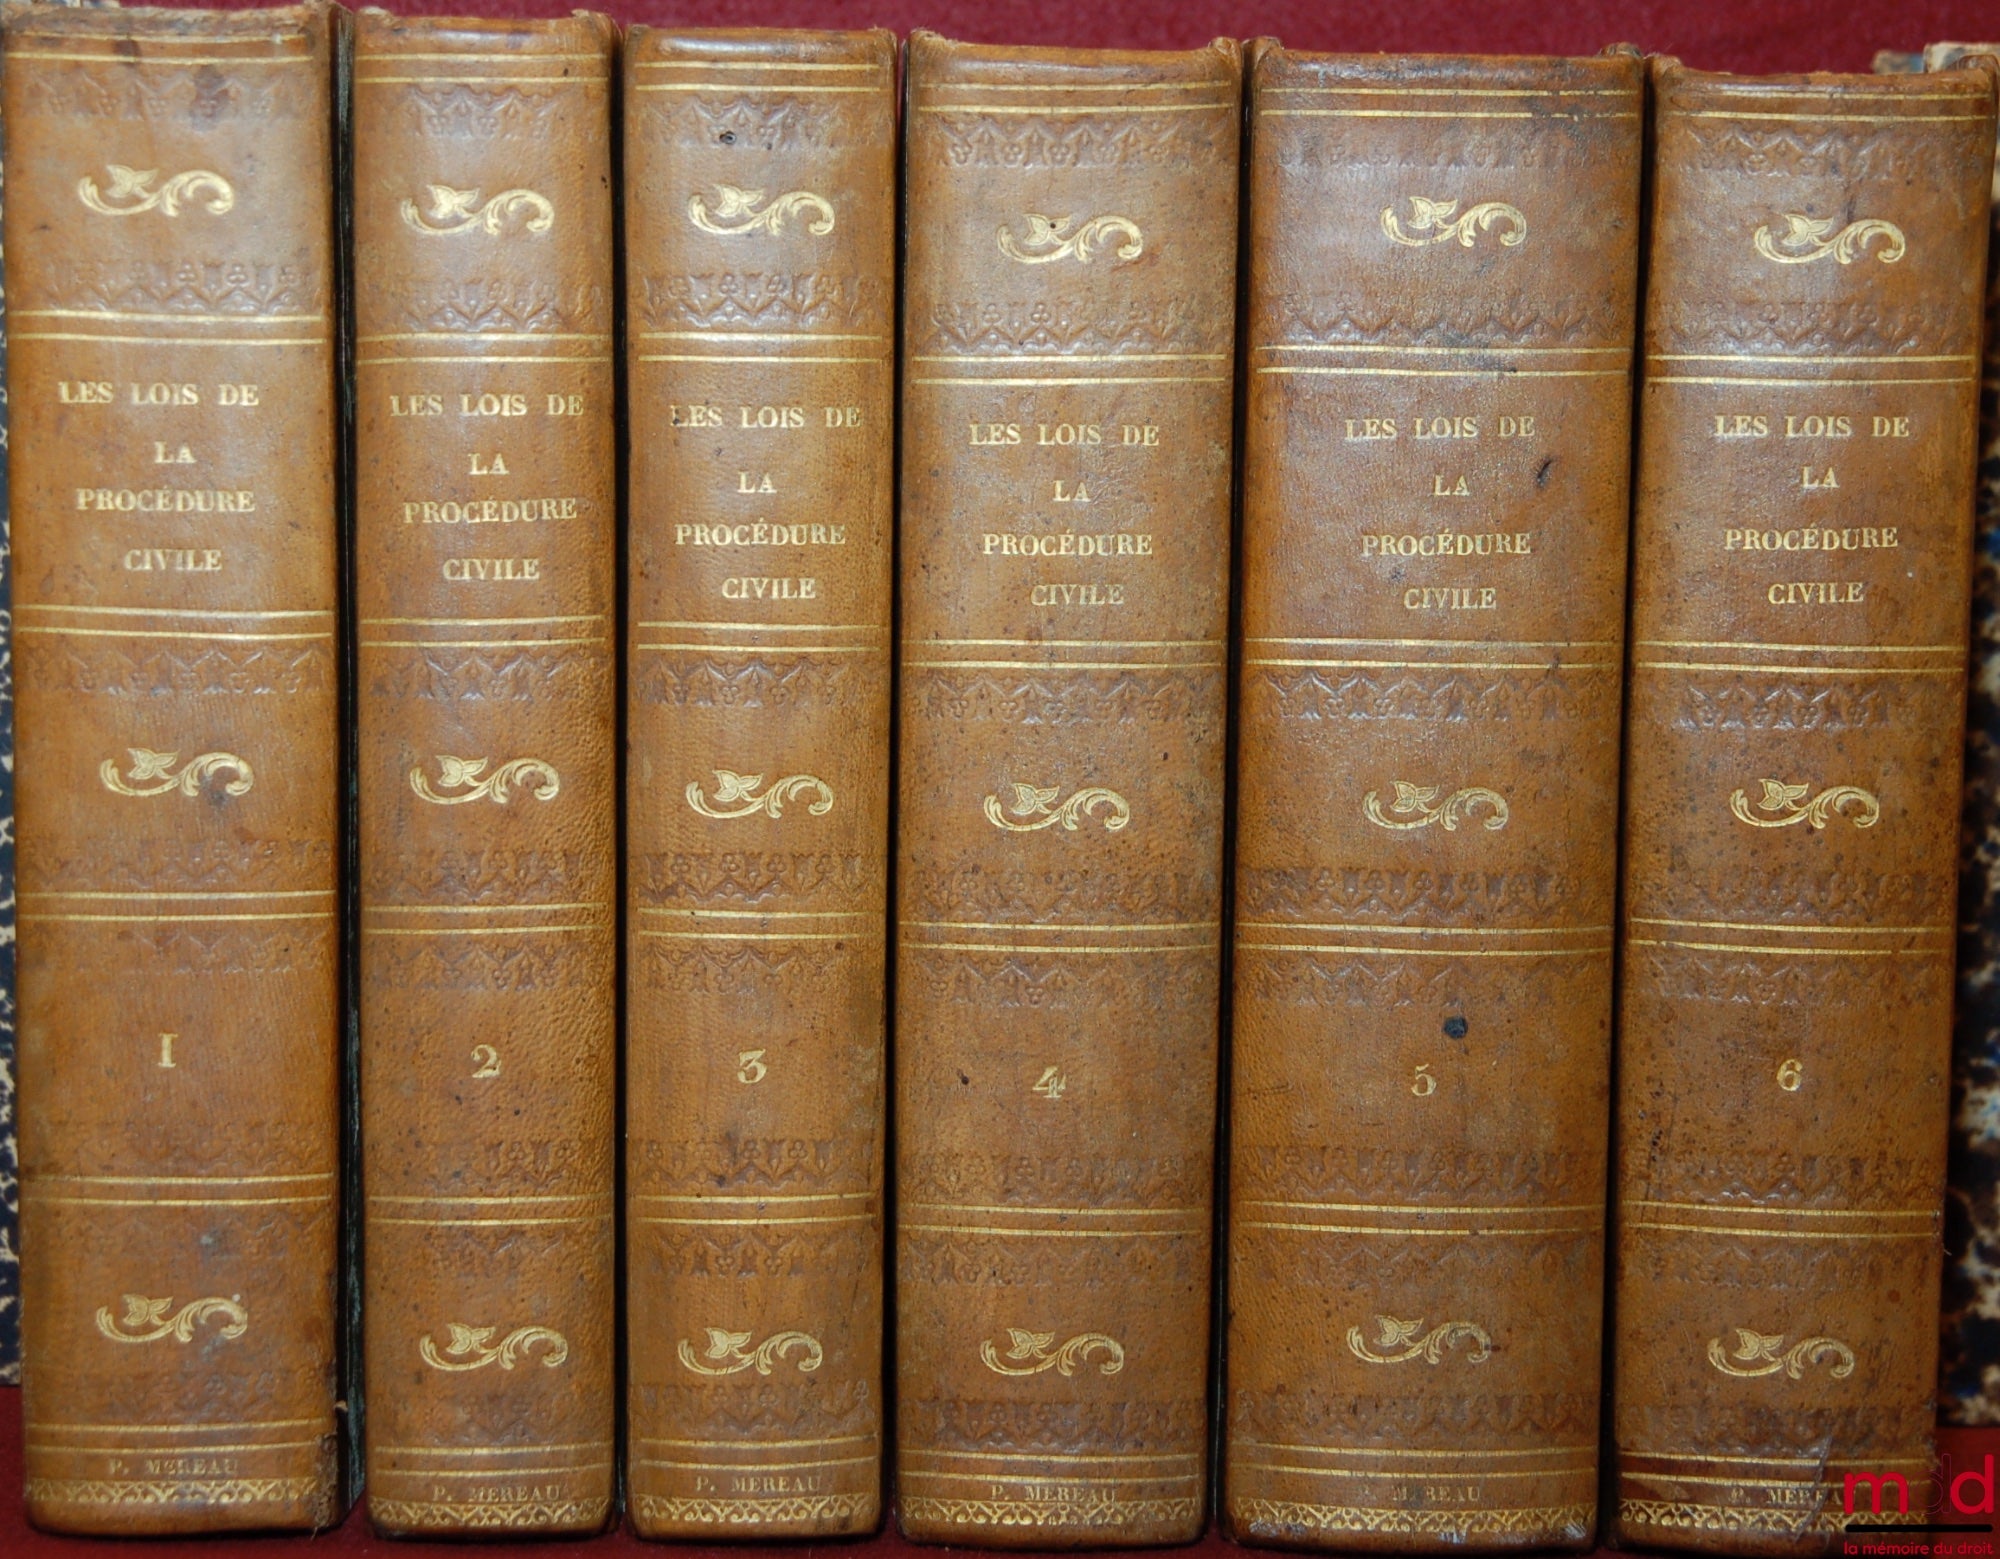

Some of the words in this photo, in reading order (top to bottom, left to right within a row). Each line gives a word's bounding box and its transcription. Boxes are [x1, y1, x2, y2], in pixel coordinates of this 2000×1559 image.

[59, 381, 114, 405] LES
[131, 382, 200, 406] LOIS
[218, 383, 260, 406] DE
[390, 394, 444, 417] LES
[461, 394, 527, 416] LOIS
[547, 395, 584, 416] DE
[670, 405, 723, 428] LES
[741, 406, 804, 428] LOIS
[825, 406, 861, 428] DE
[969, 424, 1021, 445] LES
[1037, 424, 1101, 445] LOIS
[1122, 424, 1159, 446] DE
[1345, 418, 1397, 441] LES
[1414, 417, 1477, 440] LOIS
[1499, 415, 1536, 438] DE
[1715, 415, 1769, 438] LES
[1785, 416, 1852, 438] LOIS
[1873, 416, 1910, 438] DE
[154, 442, 197, 464] LA
[468, 453, 510, 475] LA
[737, 471, 778, 494] LA
[1434, 475, 1470, 498] LA
[1801, 467, 1840, 489] LA
[75, 484, 256, 512] PROCÉDURE
[1053, 480, 1092, 502] LA
[403, 495, 578, 523] PROCÉDURE
[675, 517, 846, 545] PROCÉDURE
[983, 527, 1153, 556] PROCÉDURE
[1361, 528, 1532, 556] PROCÉDURE
[1724, 524, 1899, 551] PROCÉDURE
[123, 548, 222, 571] CIVILE
[443, 558, 540, 581] CIVILE
[721, 578, 816, 599] CIVILE
[1030, 584, 1124, 606] CIVILE
[1404, 588, 1497, 610] CIVILE
[1768, 582, 1864, 604] CIVILE
[471, 1044, 502, 1079] 2
[737, 1047, 768, 1085] 3
[1032, 1065, 1067, 1099] 4
[1410, 1063, 1437, 1097] 5
[1775, 1058, 1803, 1092] 6
[109, 1458, 130, 1475] P.
[433, 1486, 452, 1502] P.
[696, 1476, 716, 1492] P.
[731, 1475, 822, 1493] MEREAU
[991, 1484, 1010, 1501] P.
[1024, 1486, 1116, 1502] MEREAU
[1393, 1486, 1480, 1501] MREAU
